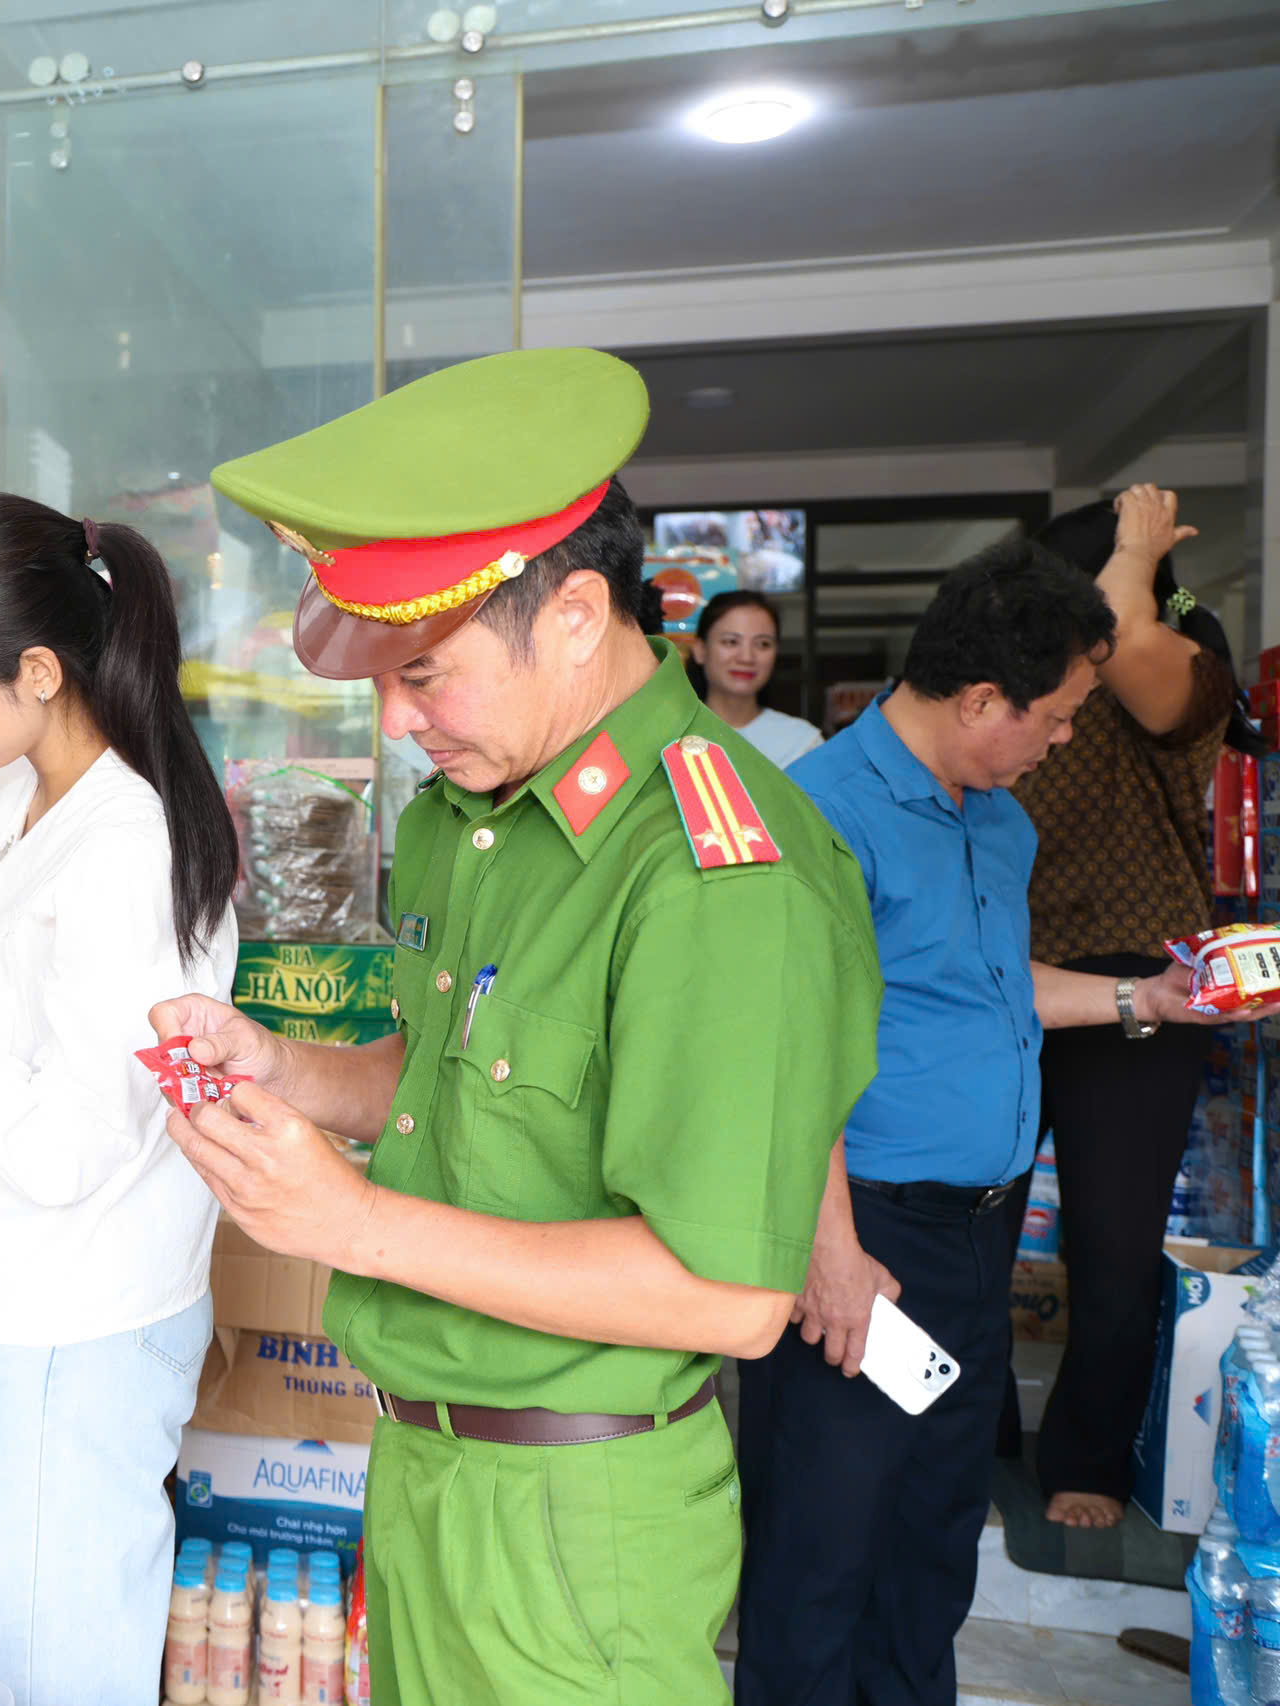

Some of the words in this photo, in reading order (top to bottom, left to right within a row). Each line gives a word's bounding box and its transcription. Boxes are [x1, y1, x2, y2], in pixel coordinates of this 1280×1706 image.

[280, 945, 315, 968] BIA
[250, 969, 290, 1002] HÀ
[295, 972, 346, 1011] NỘI
[284, 1019, 319, 1042] BIA
[256, 1334, 339, 1369] BÌNH
[283, 1375, 347, 1398] THÙNG
[252, 1457, 368, 1498] AQUAFINA
[227, 1522, 248, 1535] Cho
[275, 1515, 300, 1531] Chai
